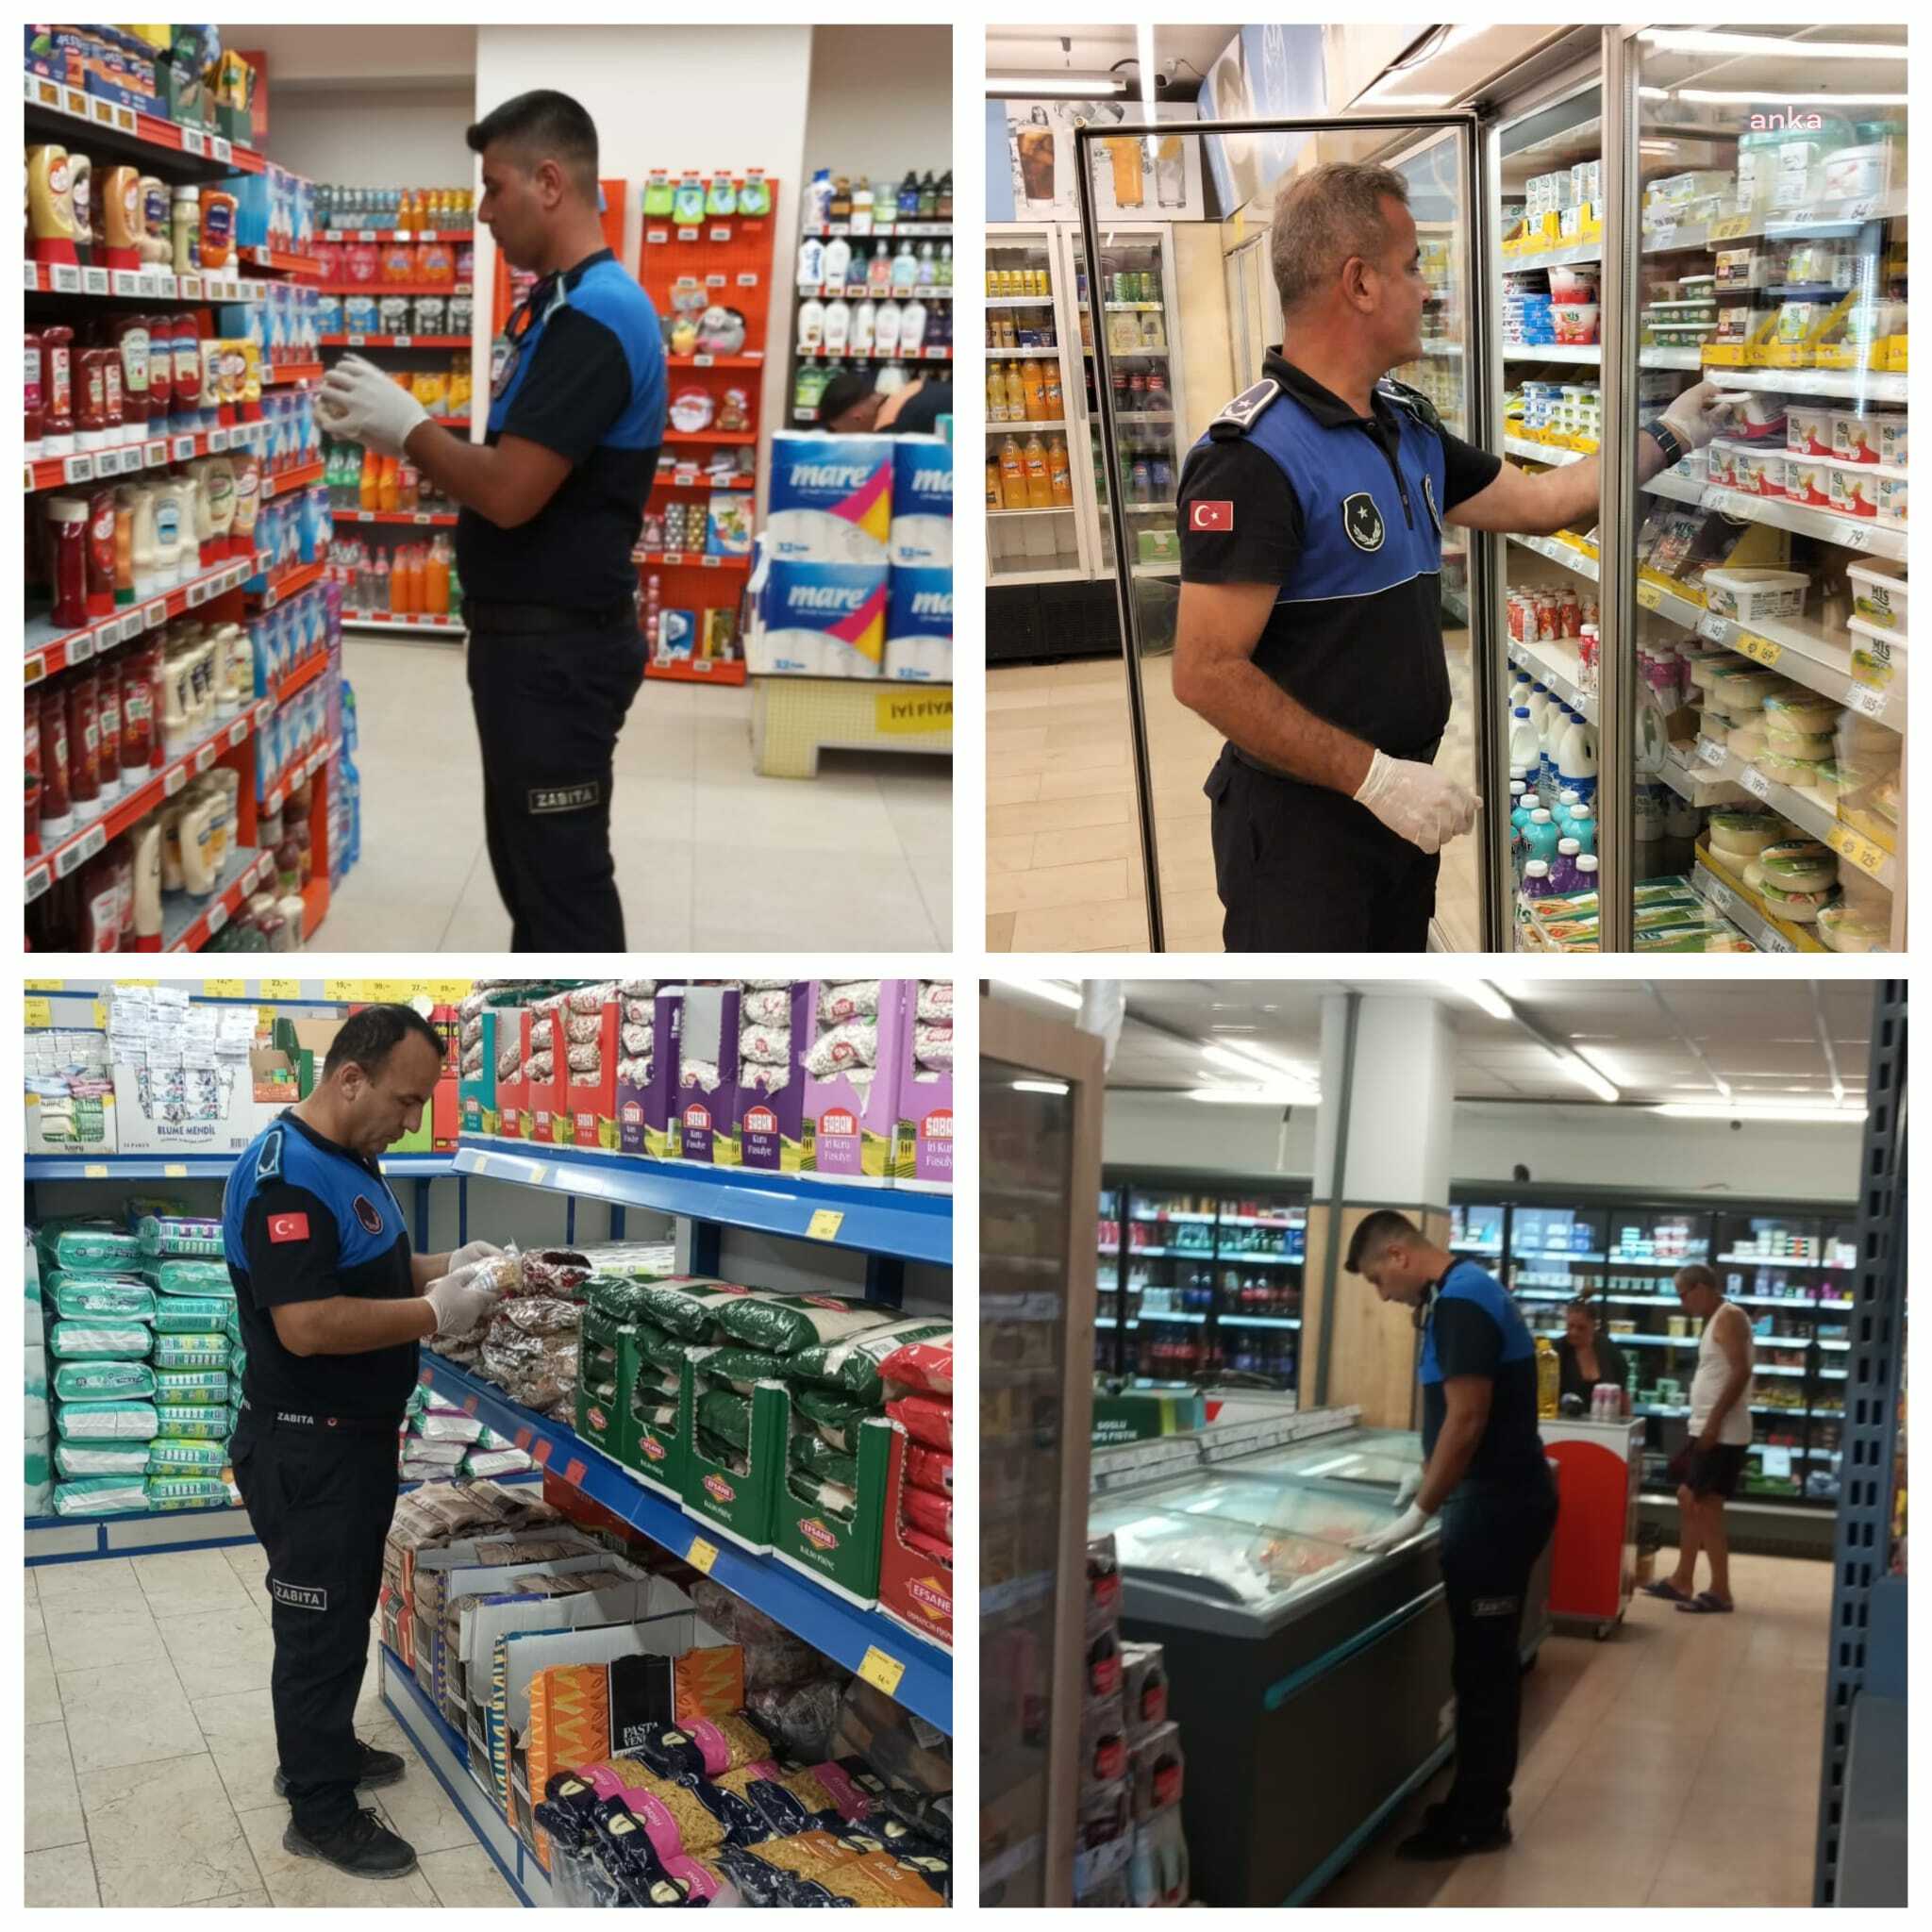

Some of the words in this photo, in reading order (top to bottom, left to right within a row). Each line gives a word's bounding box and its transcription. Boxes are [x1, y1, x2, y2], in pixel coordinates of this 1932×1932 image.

[789, 464, 871, 487] mare
[787, 585, 868, 608] mare
[537, 789, 592, 808] ZABITA
[824, 1115, 853, 1134] SABAN
[276, 1412, 314, 1424] ZABITA
[804, 1524, 831, 1543] EFSANE
[276, 1586, 319, 1605] ZABITA
[913, 1584, 951, 1611] EFSANE
